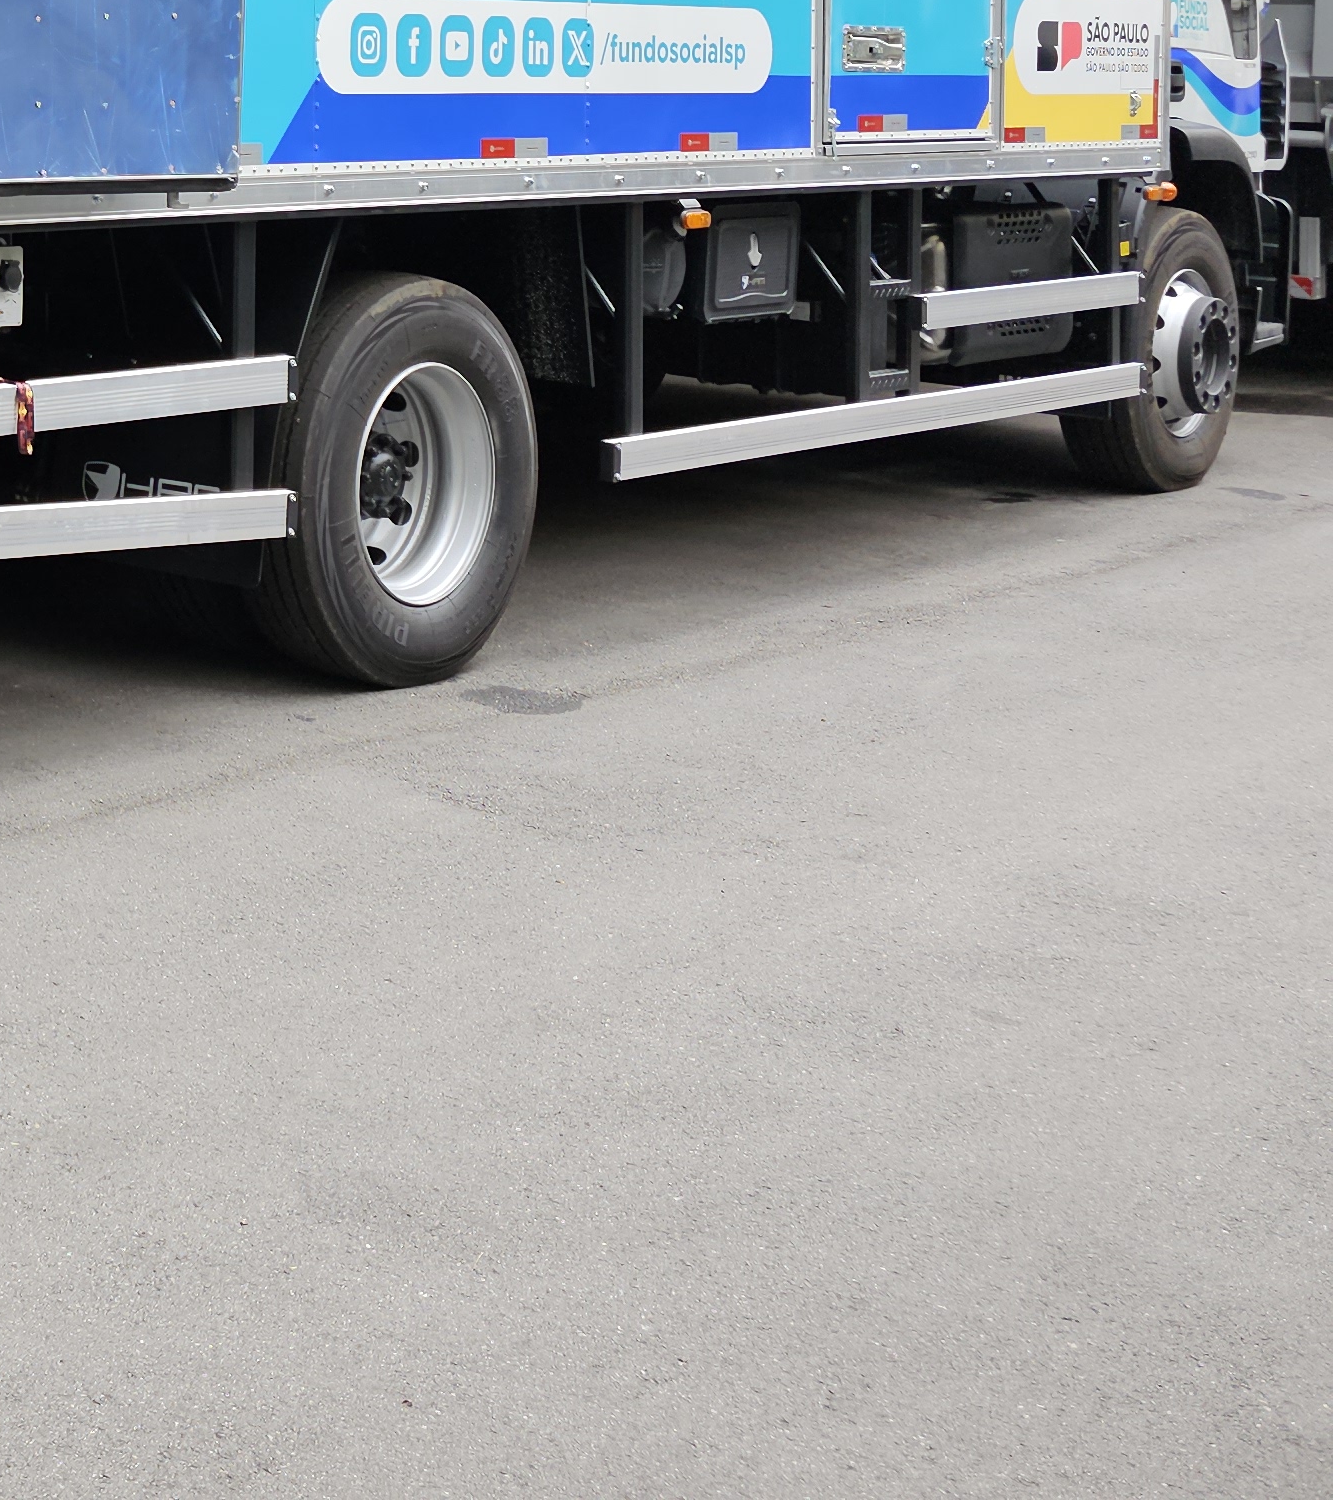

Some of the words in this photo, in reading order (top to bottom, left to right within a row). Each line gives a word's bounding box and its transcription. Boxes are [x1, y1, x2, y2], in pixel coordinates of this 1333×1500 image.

[1179, 0, 1208, 16] FUNDO
[1086, 16, 1110, 44] SÃO
[1113, 23, 1149, 44] PAULO
[1179, 16, 1209, 32] SOCIAL
[600, 32, 745, 70] /fundosocialsp
[1086, 47, 1115, 56] GOVERNO
[1117, 48, 1126, 56] DO
[1127, 48, 1149, 58] ESTADO
[1086, 61, 1097, 72] SÃO
[1099, 64, 1116, 72] PAULO
[1117, 62, 1129, 72] SÃO
[1131, 64, 1149, 73] TODOS
